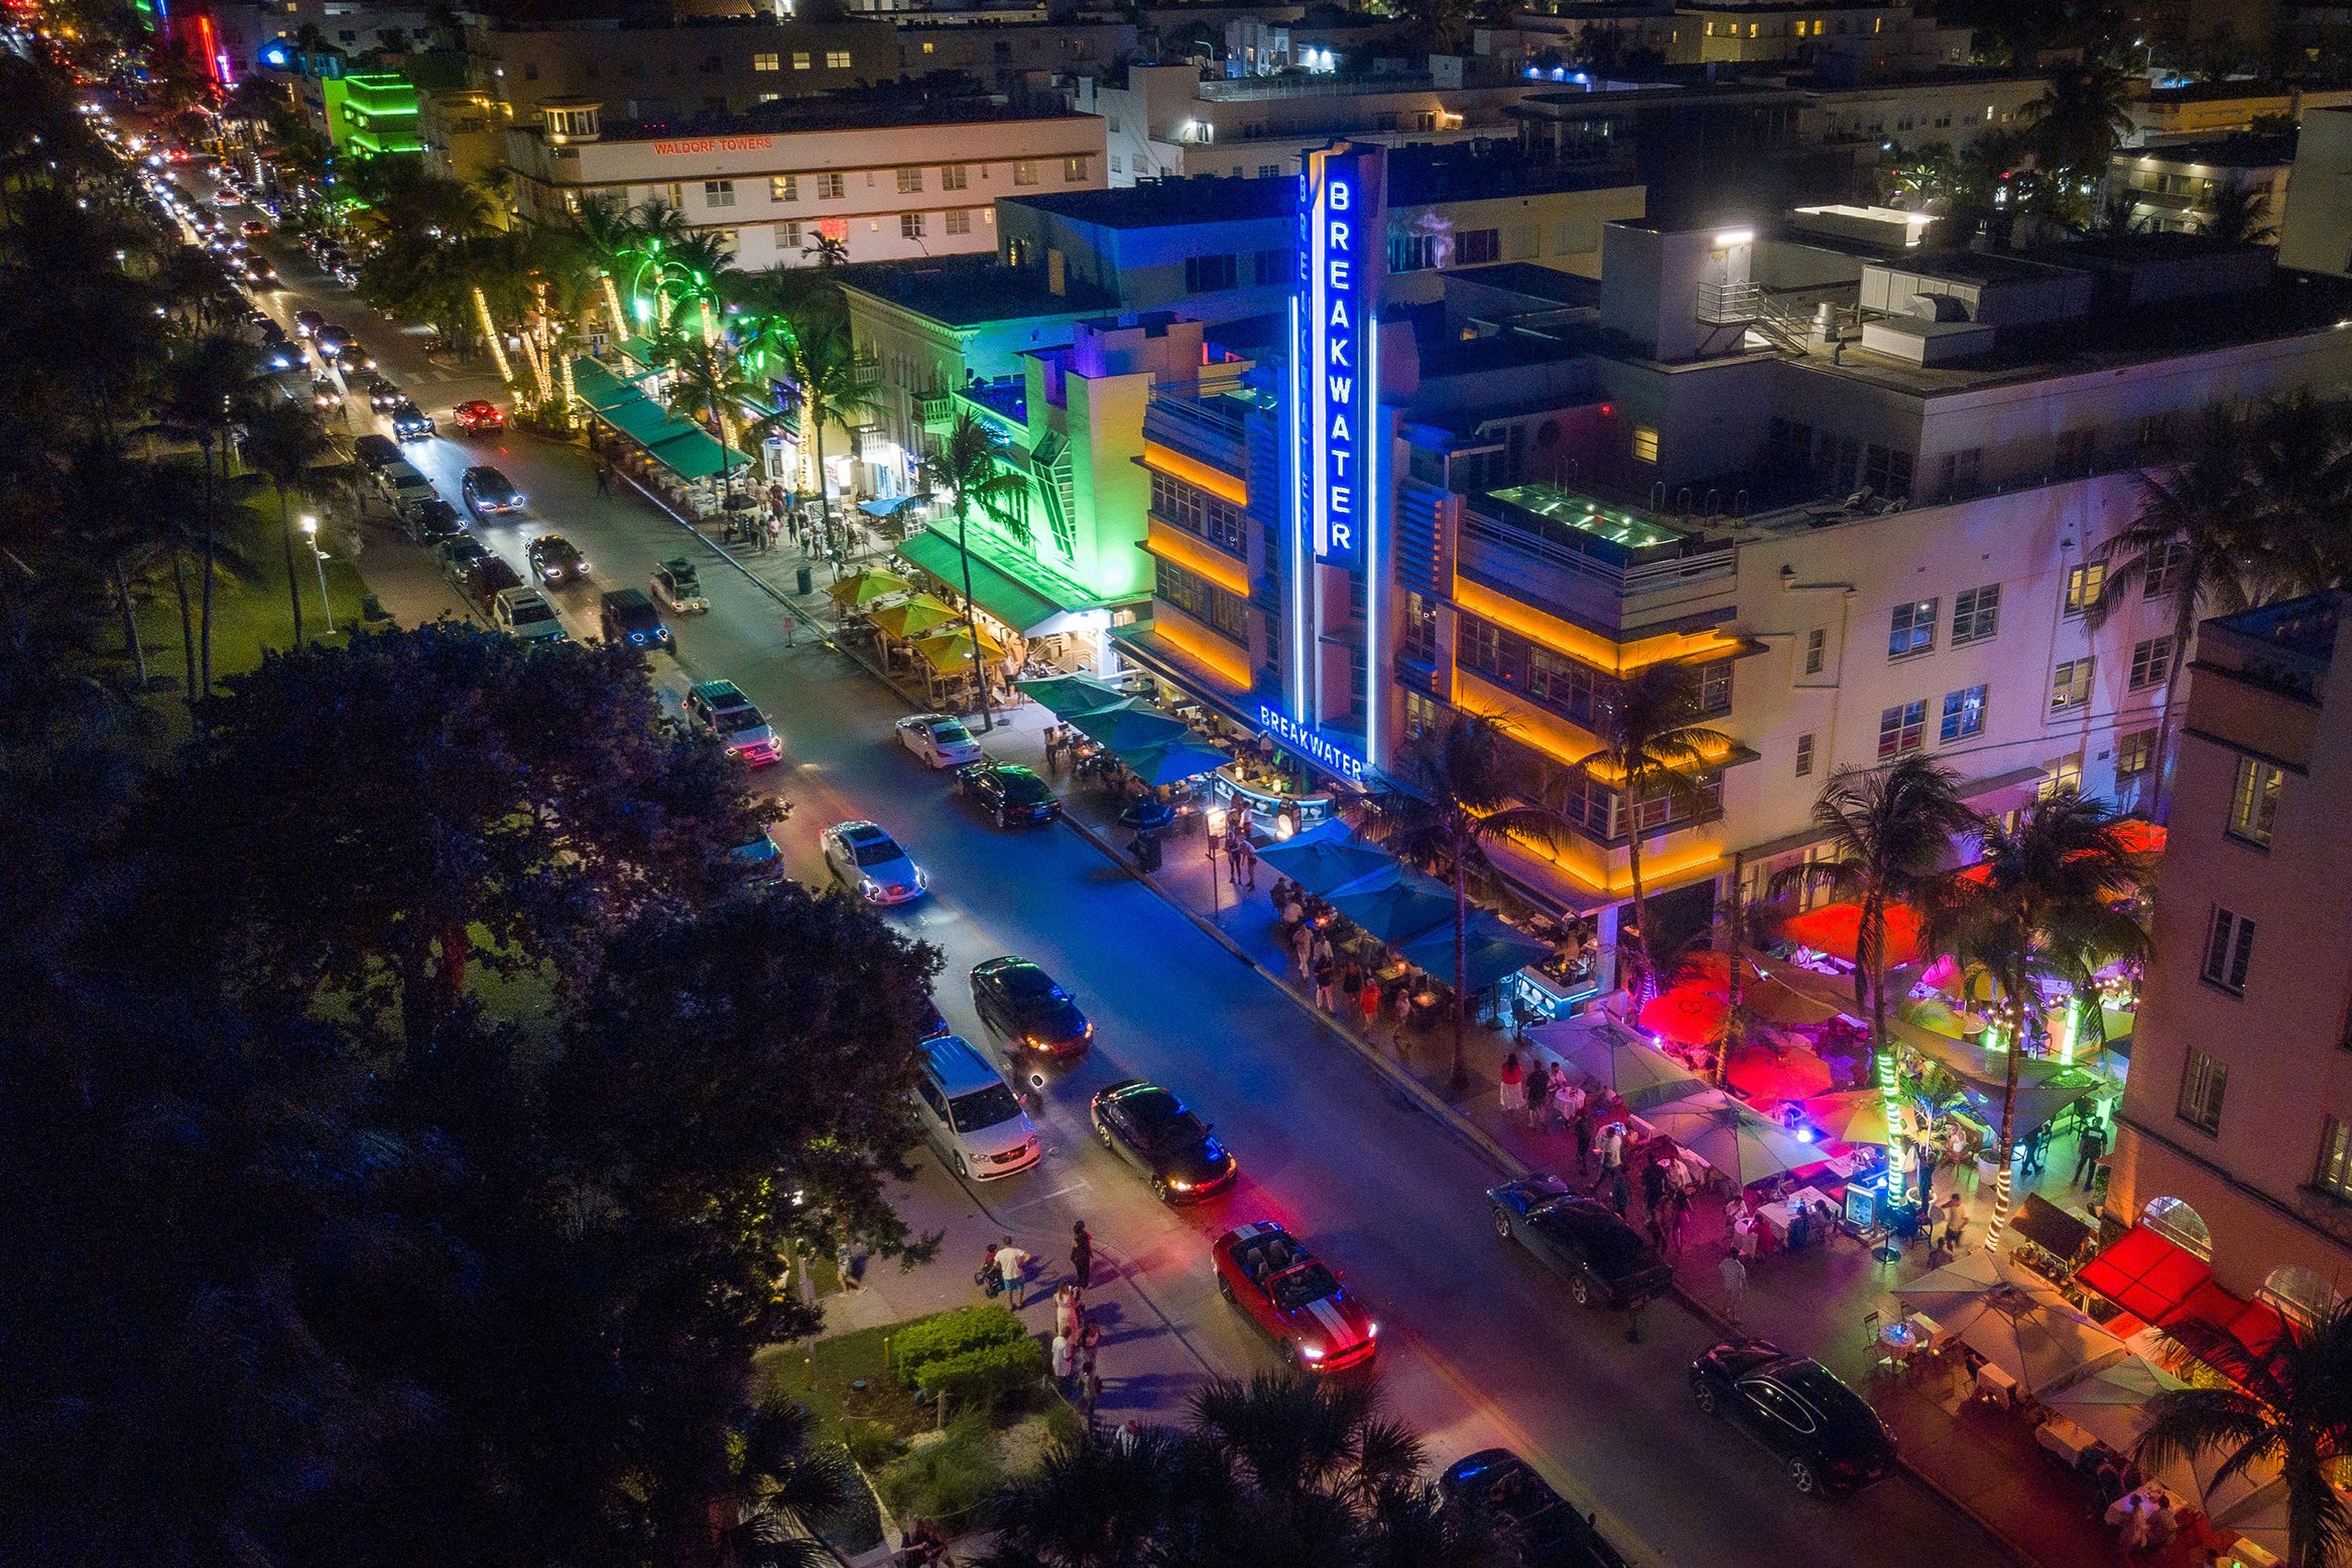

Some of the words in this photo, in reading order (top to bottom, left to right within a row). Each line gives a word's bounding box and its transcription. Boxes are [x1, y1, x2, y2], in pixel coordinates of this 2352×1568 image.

[653, 141, 716, 154] WALDORF
[719, 138, 773, 152] TOWERS
[1329, 181, 1351, 549] BREAKWATER
[1261, 705, 1363, 781] BREAKWATER
